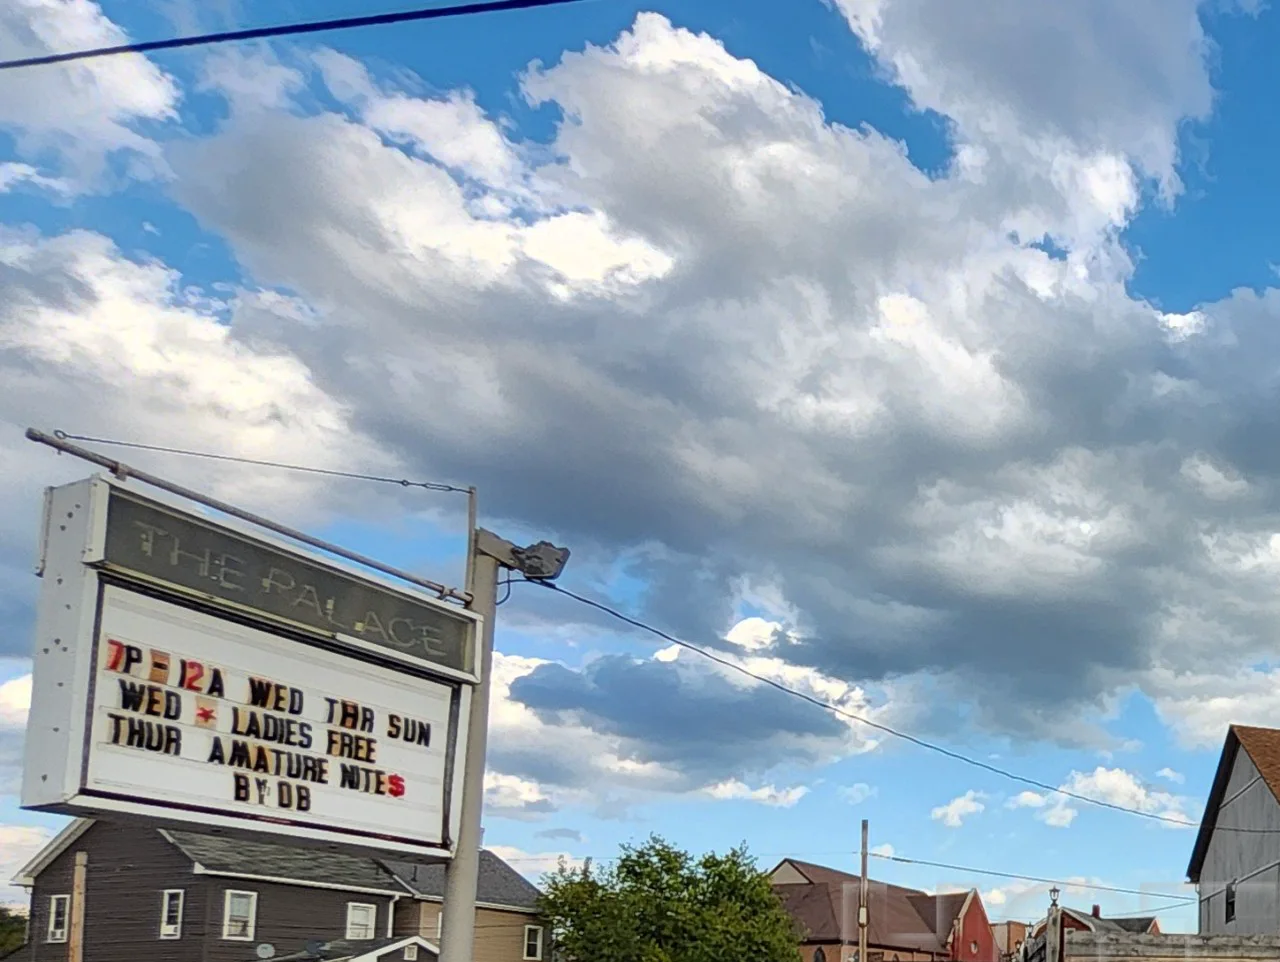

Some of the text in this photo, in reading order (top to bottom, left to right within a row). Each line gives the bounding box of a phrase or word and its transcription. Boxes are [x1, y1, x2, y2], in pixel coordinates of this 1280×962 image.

[134, 521, 448, 657] THE PALACE
[107, 638, 143, 674] 7P
[177, 658, 225, 698] 12A
[248, 677, 304, 715] WED
[386, 713, 431, 747] SUN
[118, 678, 378, 764] WED LADIES FREE
[107, 713, 182, 756] THUR
[207, 735, 329, 785] AMATURE
